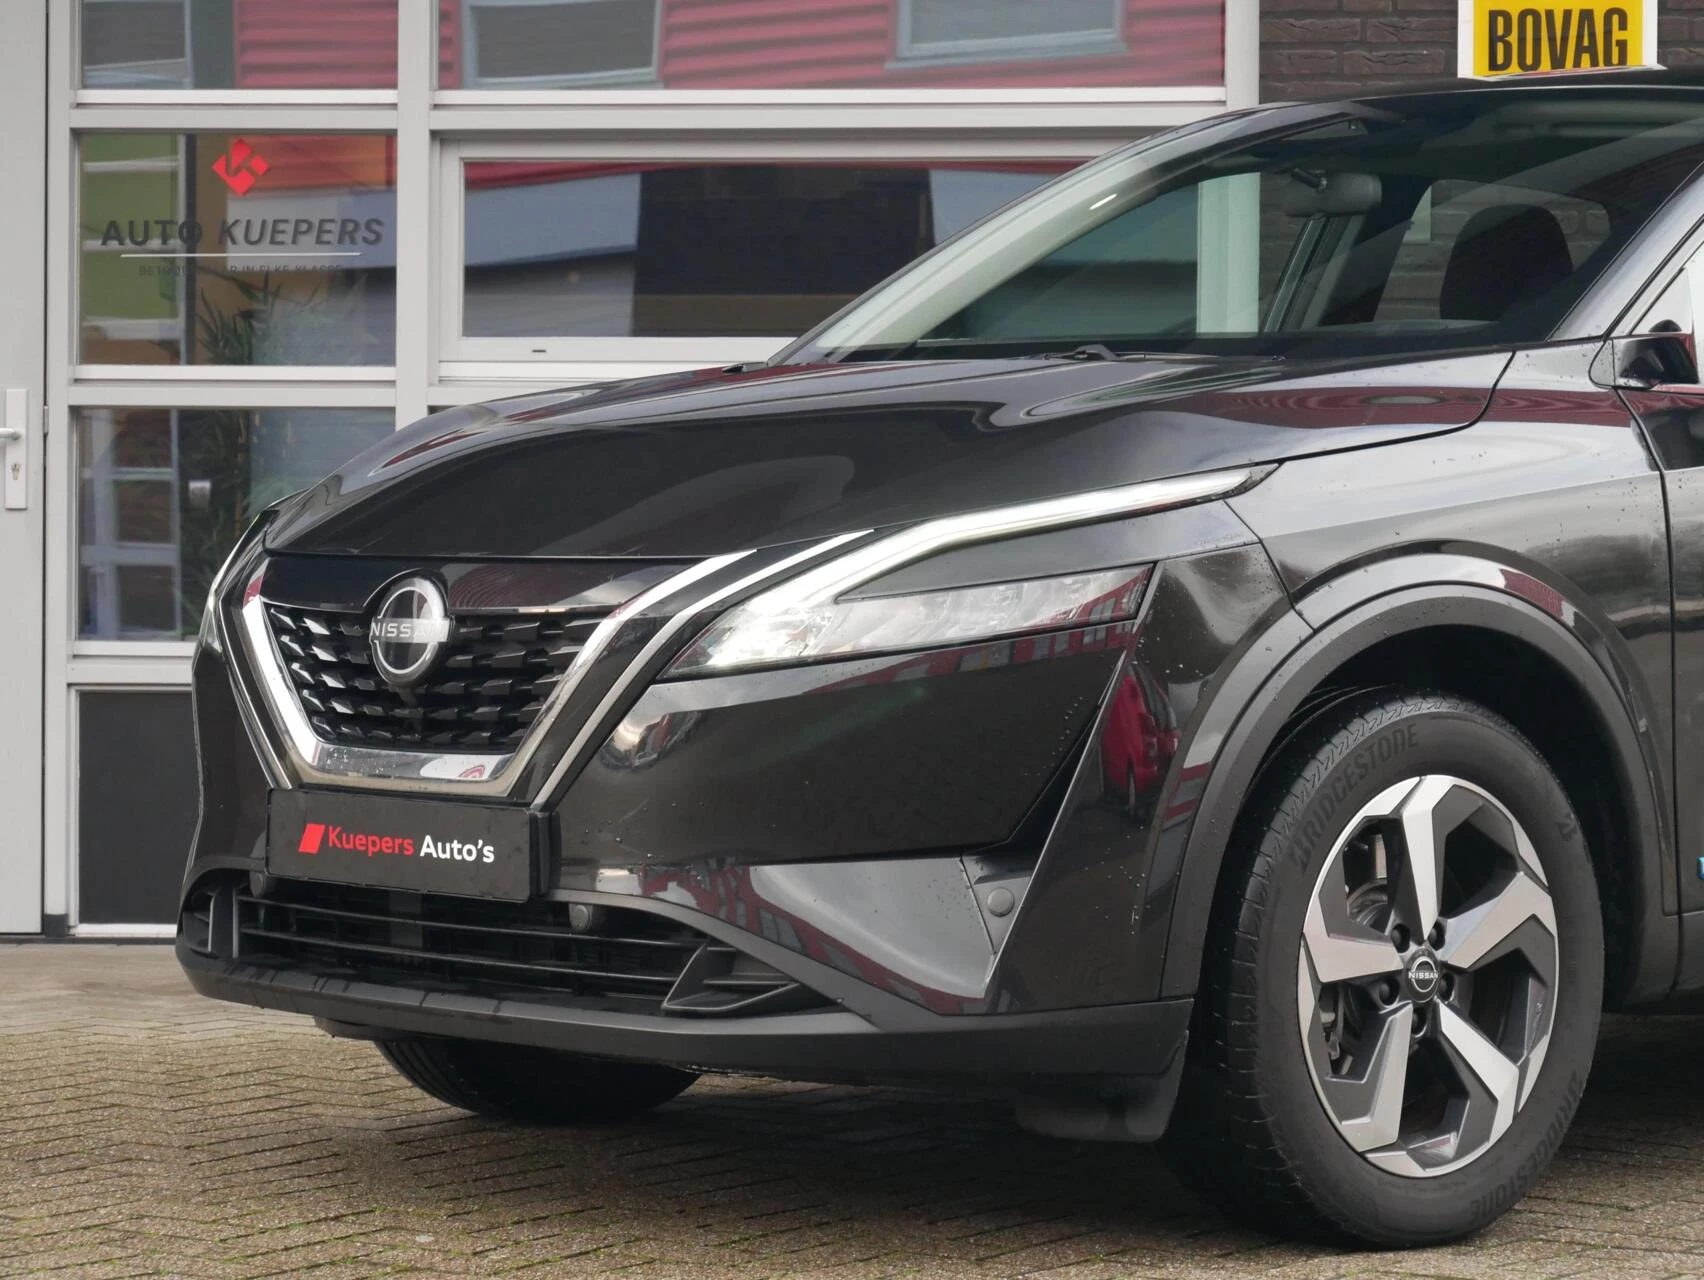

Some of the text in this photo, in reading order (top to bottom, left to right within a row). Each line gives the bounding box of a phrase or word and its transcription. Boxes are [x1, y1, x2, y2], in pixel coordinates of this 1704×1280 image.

[1488, 7, 1628, 71] BOVAG
[101, 218, 385, 247] AUTO KUEPERS
[371, 621, 447, 639] NISSAN
[1288, 722, 1420, 877] BRIDGESTONE
[328, 826, 495, 863] Kuepers Auto's
[1408, 971, 1439, 980] NISSAN
